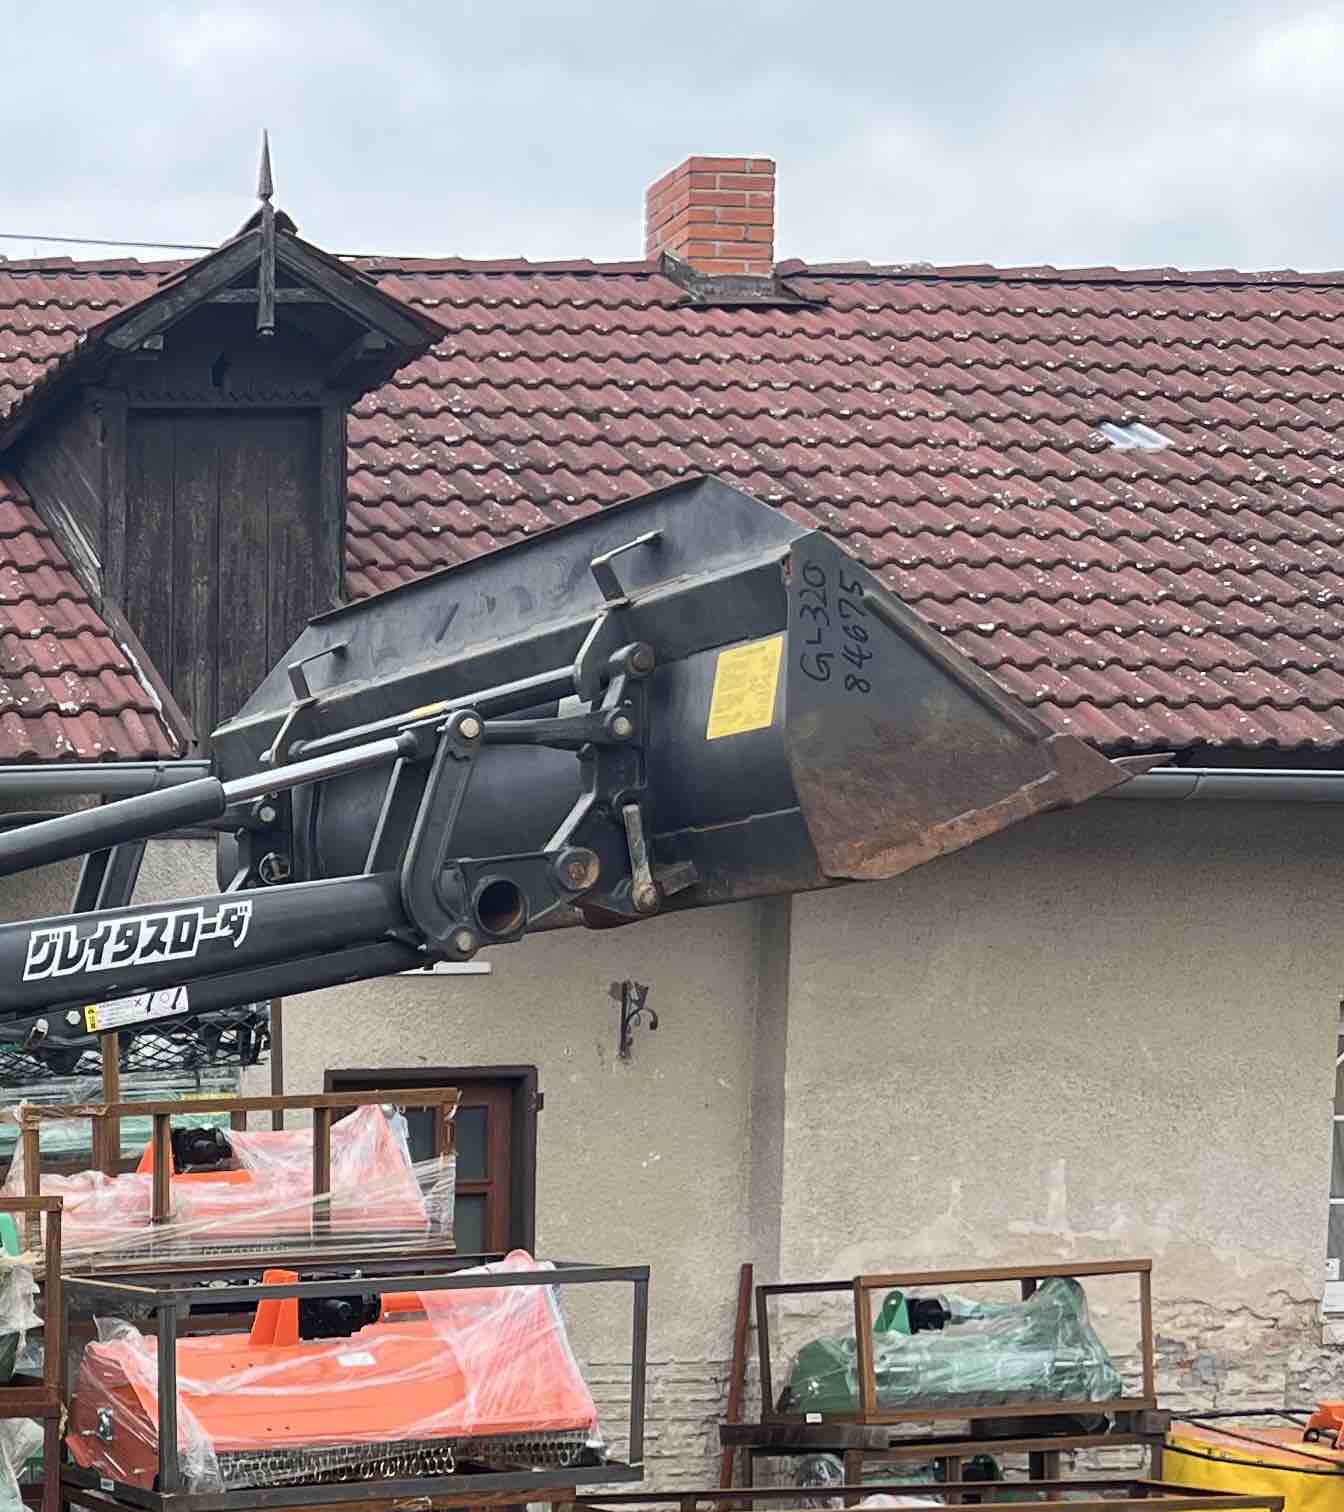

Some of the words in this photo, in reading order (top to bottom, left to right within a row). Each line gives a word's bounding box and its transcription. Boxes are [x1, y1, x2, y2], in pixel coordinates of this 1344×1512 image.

[838, 569, 873, 693] 84675
[23, 900, 252, 981] グレイタスローダ
